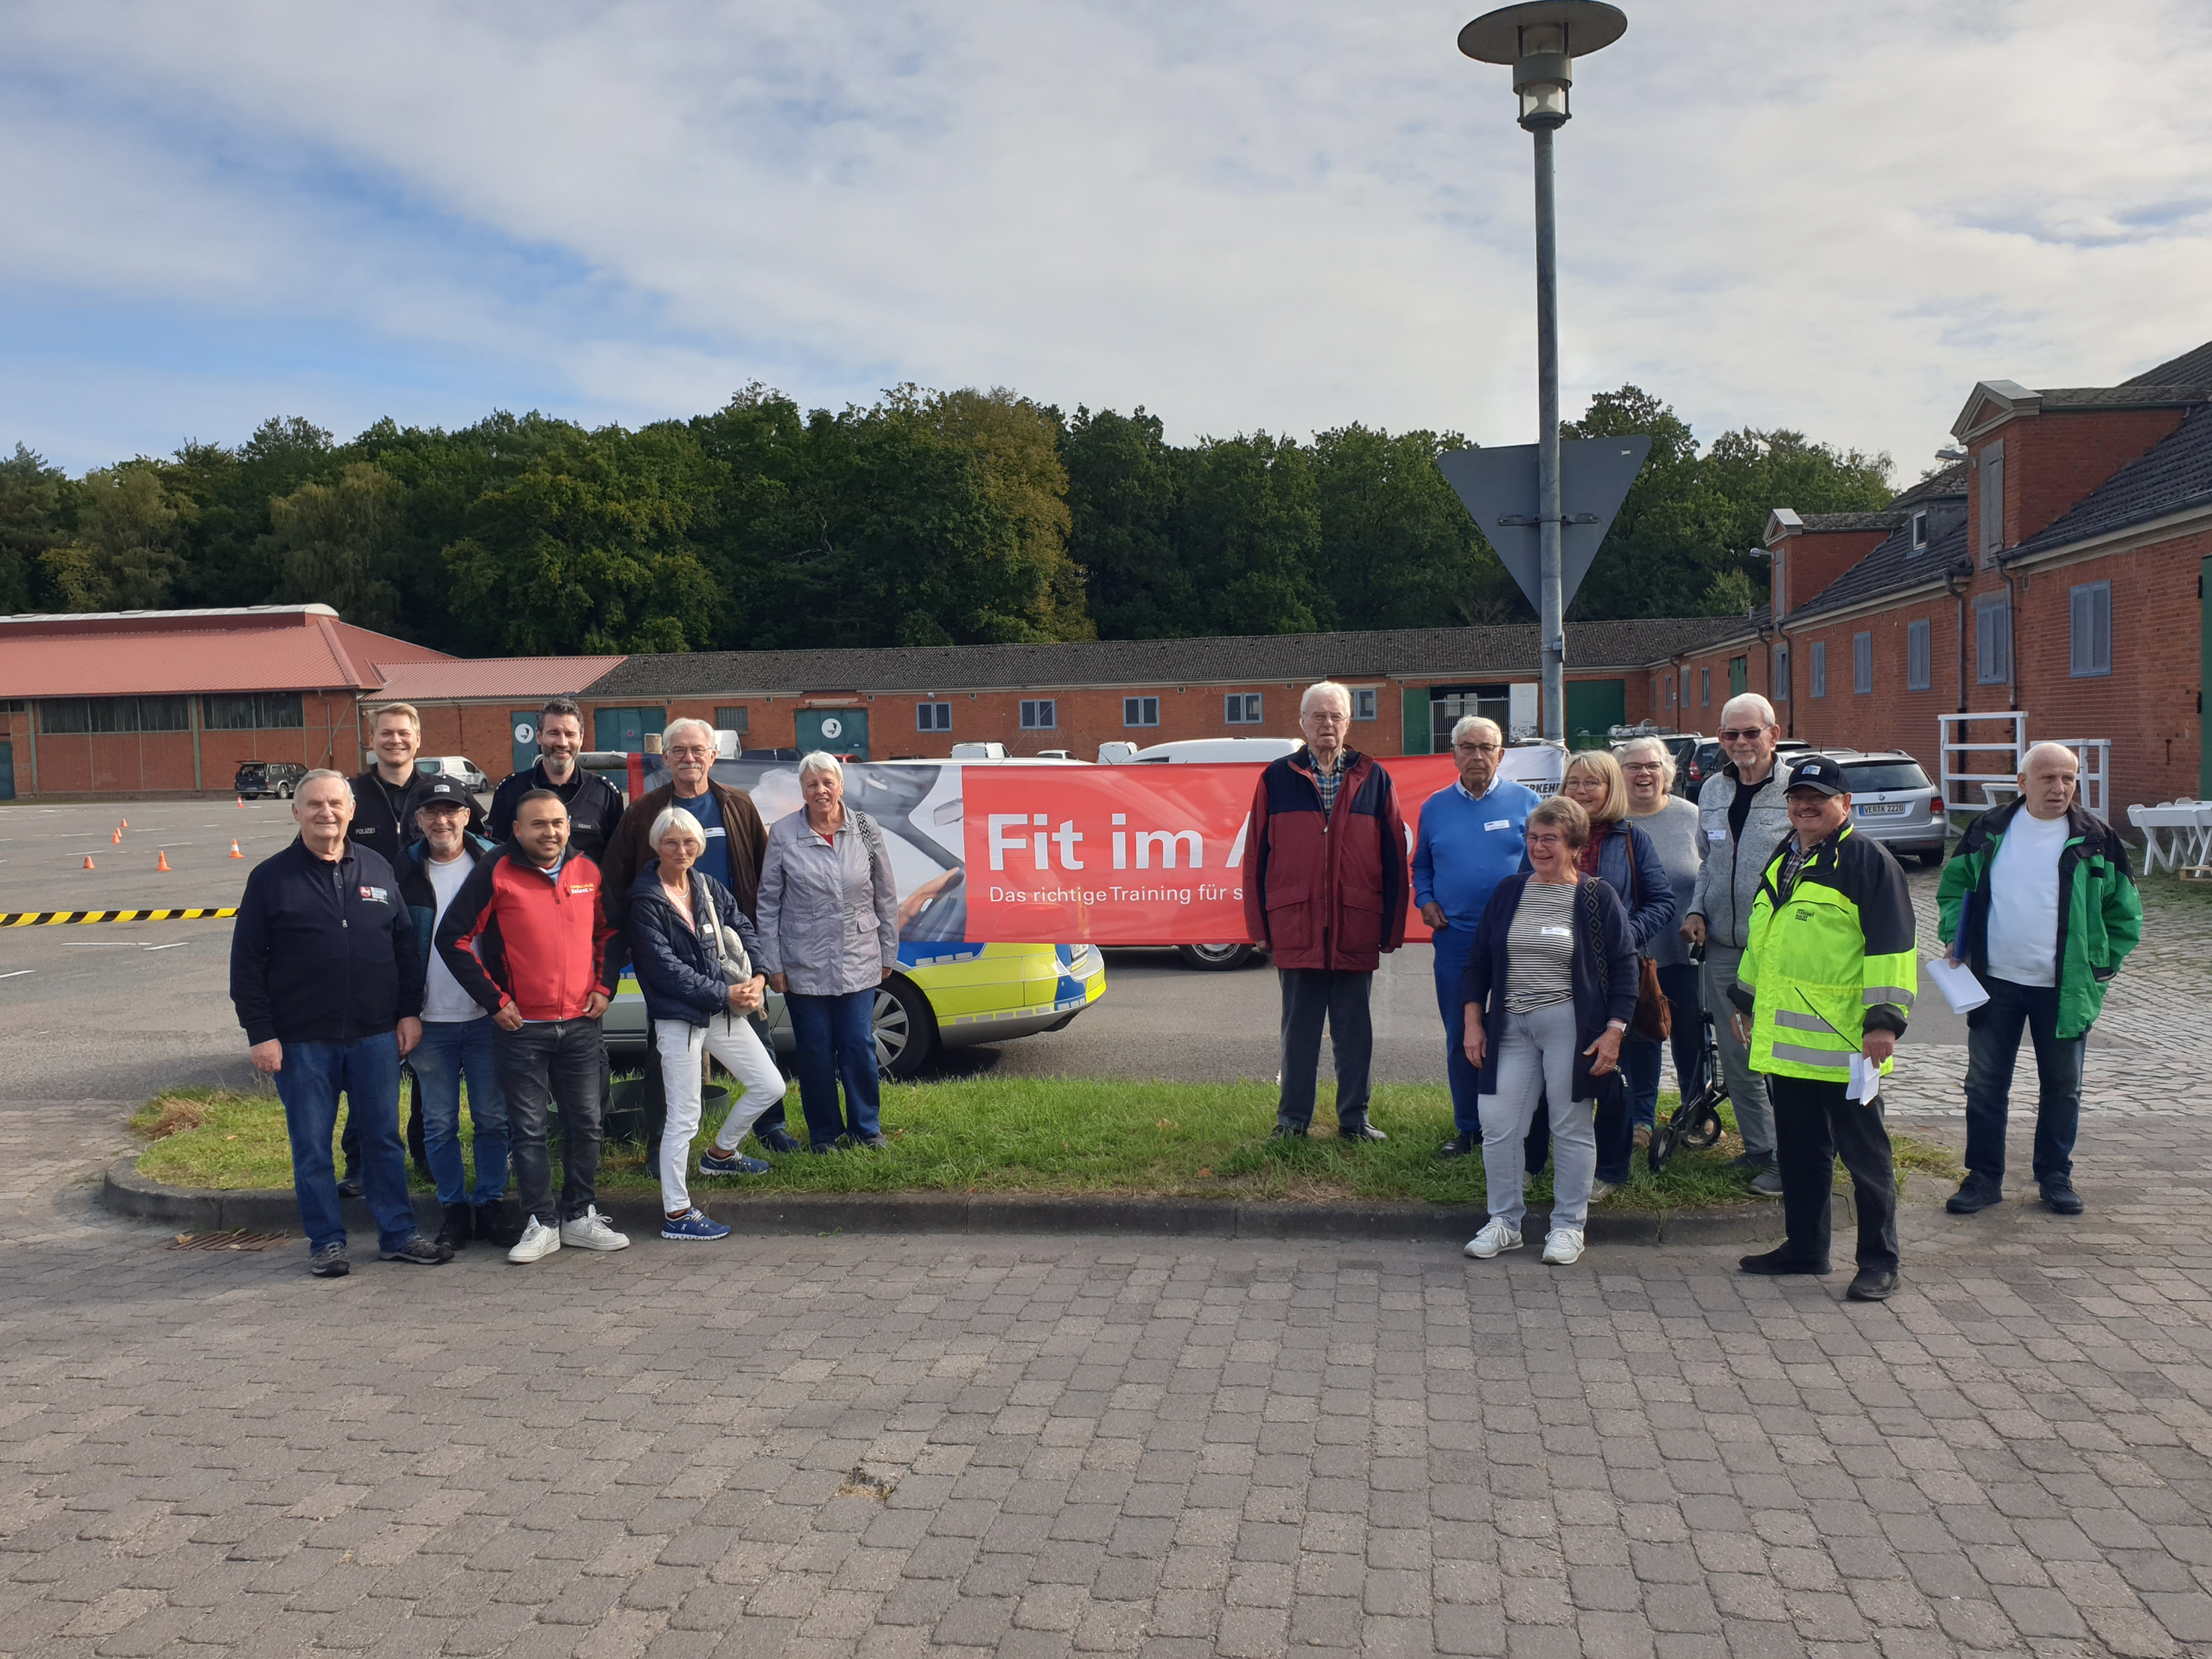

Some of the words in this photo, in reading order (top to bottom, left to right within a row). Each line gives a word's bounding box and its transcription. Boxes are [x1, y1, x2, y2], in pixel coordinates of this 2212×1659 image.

[355, 827, 376, 836] POLIZEI
[988, 813, 1084, 871] Fit
[1111, 813, 1204, 869] im
[989, 886, 1027, 902] Das
[1033, 886, 1107, 906] richtige
[1109, 885, 1192, 906] Training
[1198, 883, 1227, 900] für
